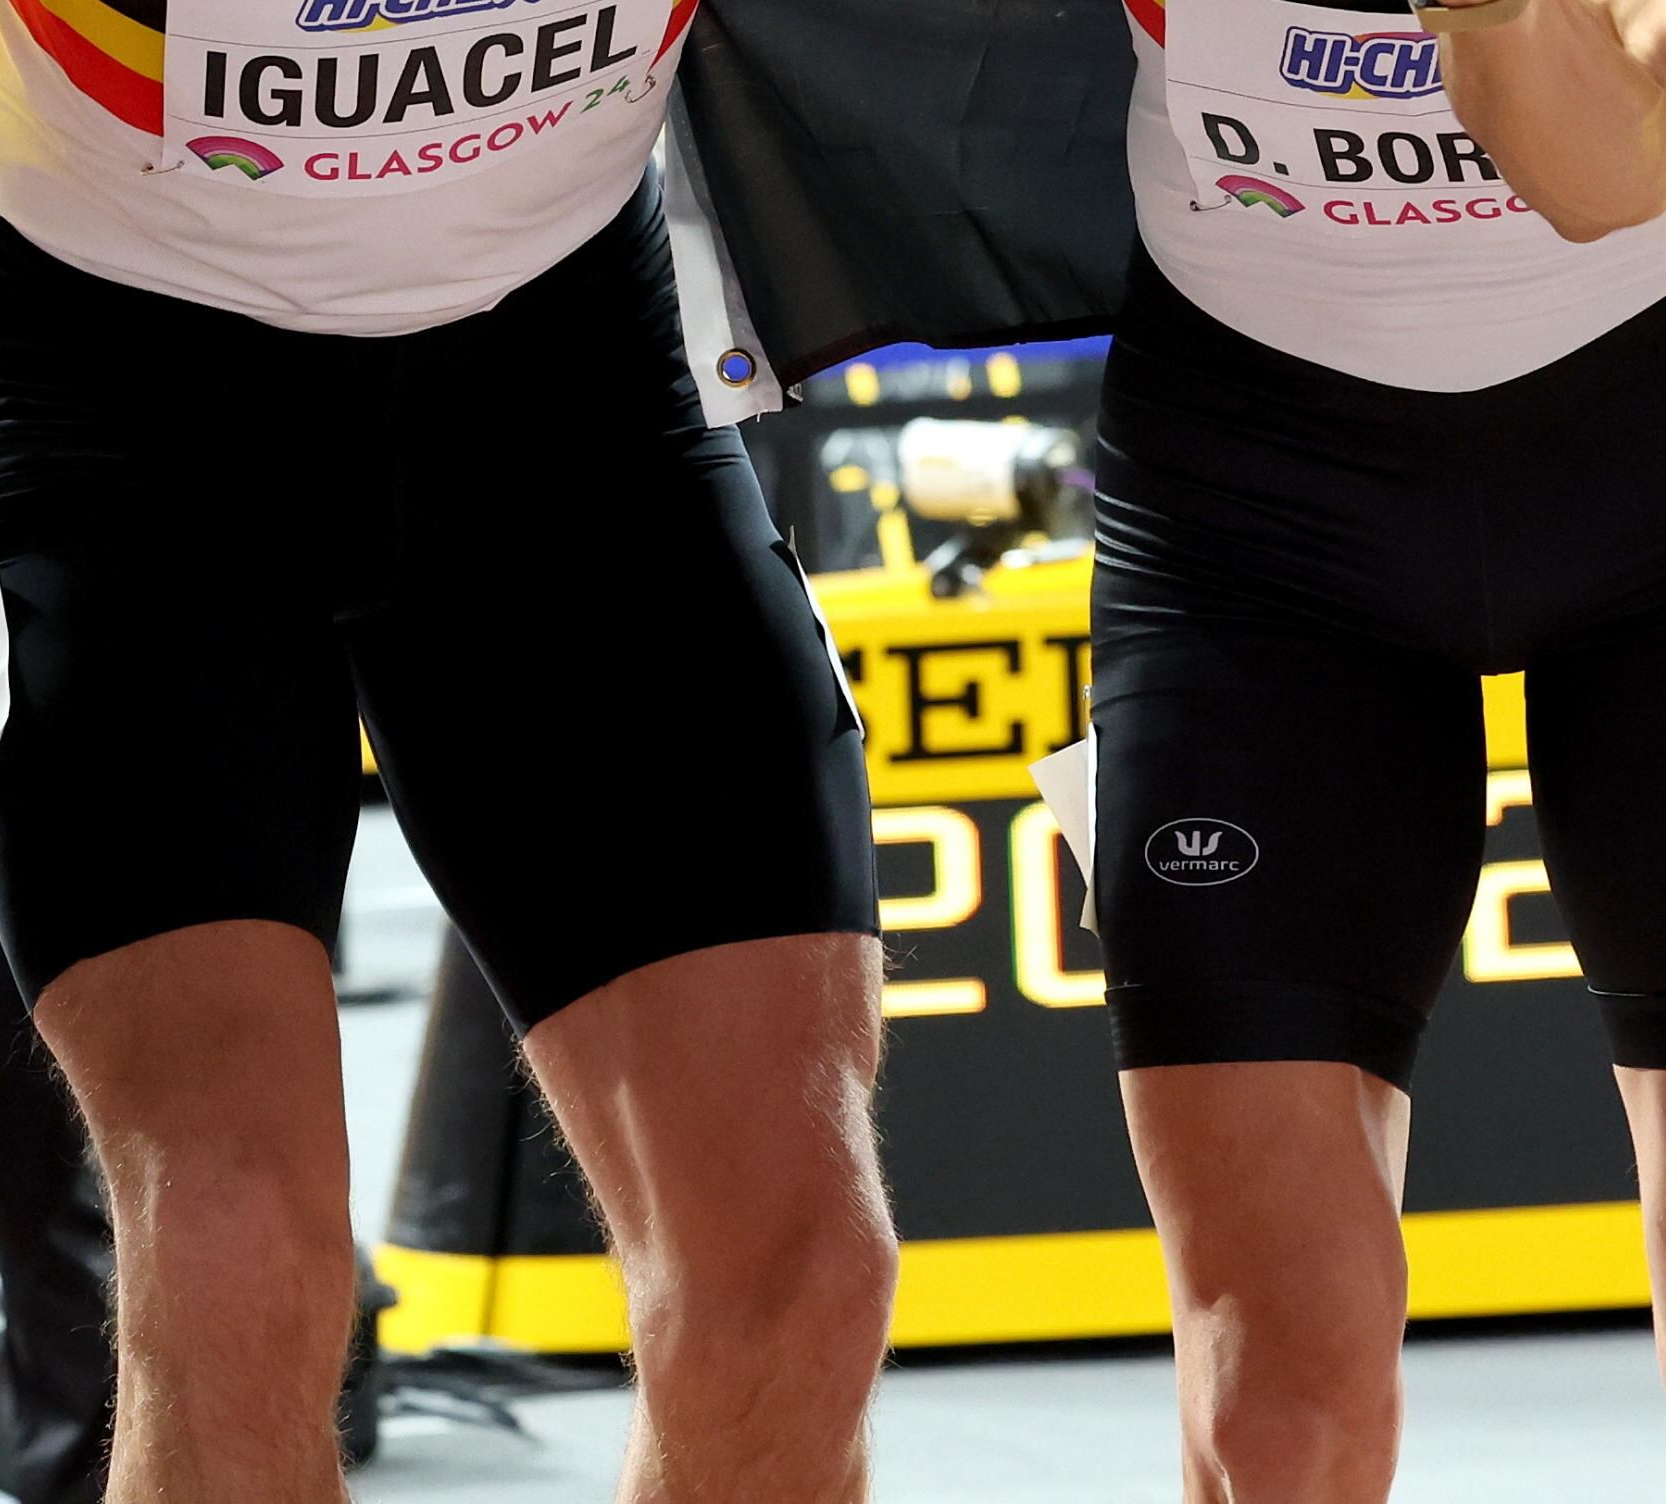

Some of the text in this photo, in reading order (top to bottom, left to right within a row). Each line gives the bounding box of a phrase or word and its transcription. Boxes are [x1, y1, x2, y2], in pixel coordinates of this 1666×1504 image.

[203, 5, 638, 129] IGUACEL
[1279, 26, 1445, 99] HI-CH
[304, 73, 631, 181] GLASGOW 24
[1201, 111, 1291, 176] D.
[1159, 859, 1240, 872] vermarc
